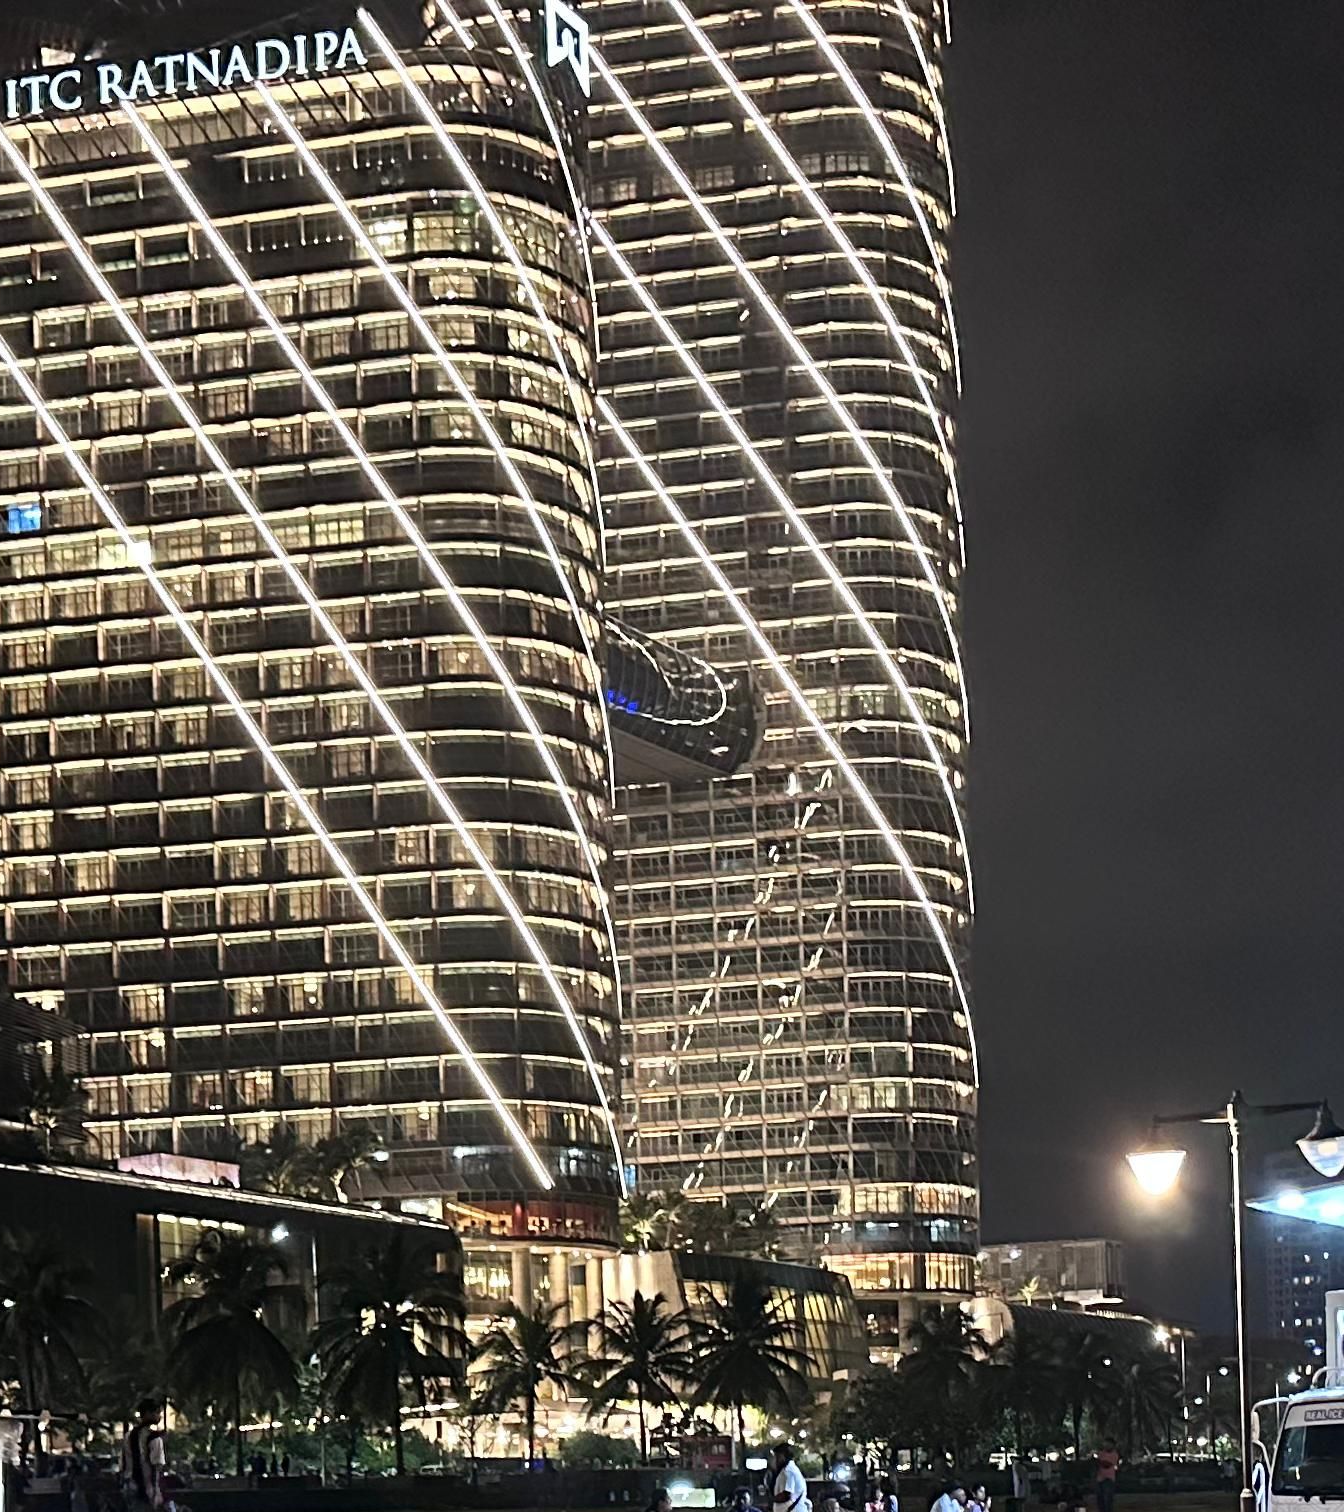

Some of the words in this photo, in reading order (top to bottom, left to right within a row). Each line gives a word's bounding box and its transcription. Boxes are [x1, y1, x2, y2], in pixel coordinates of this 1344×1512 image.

[5, 69, 82, 118] ITC
[97, 27, 368, 104] RATNADIPA
[1305, 1410, 1327, 1421] REAL
[1328, 1409, 1344, 1419] ICE
